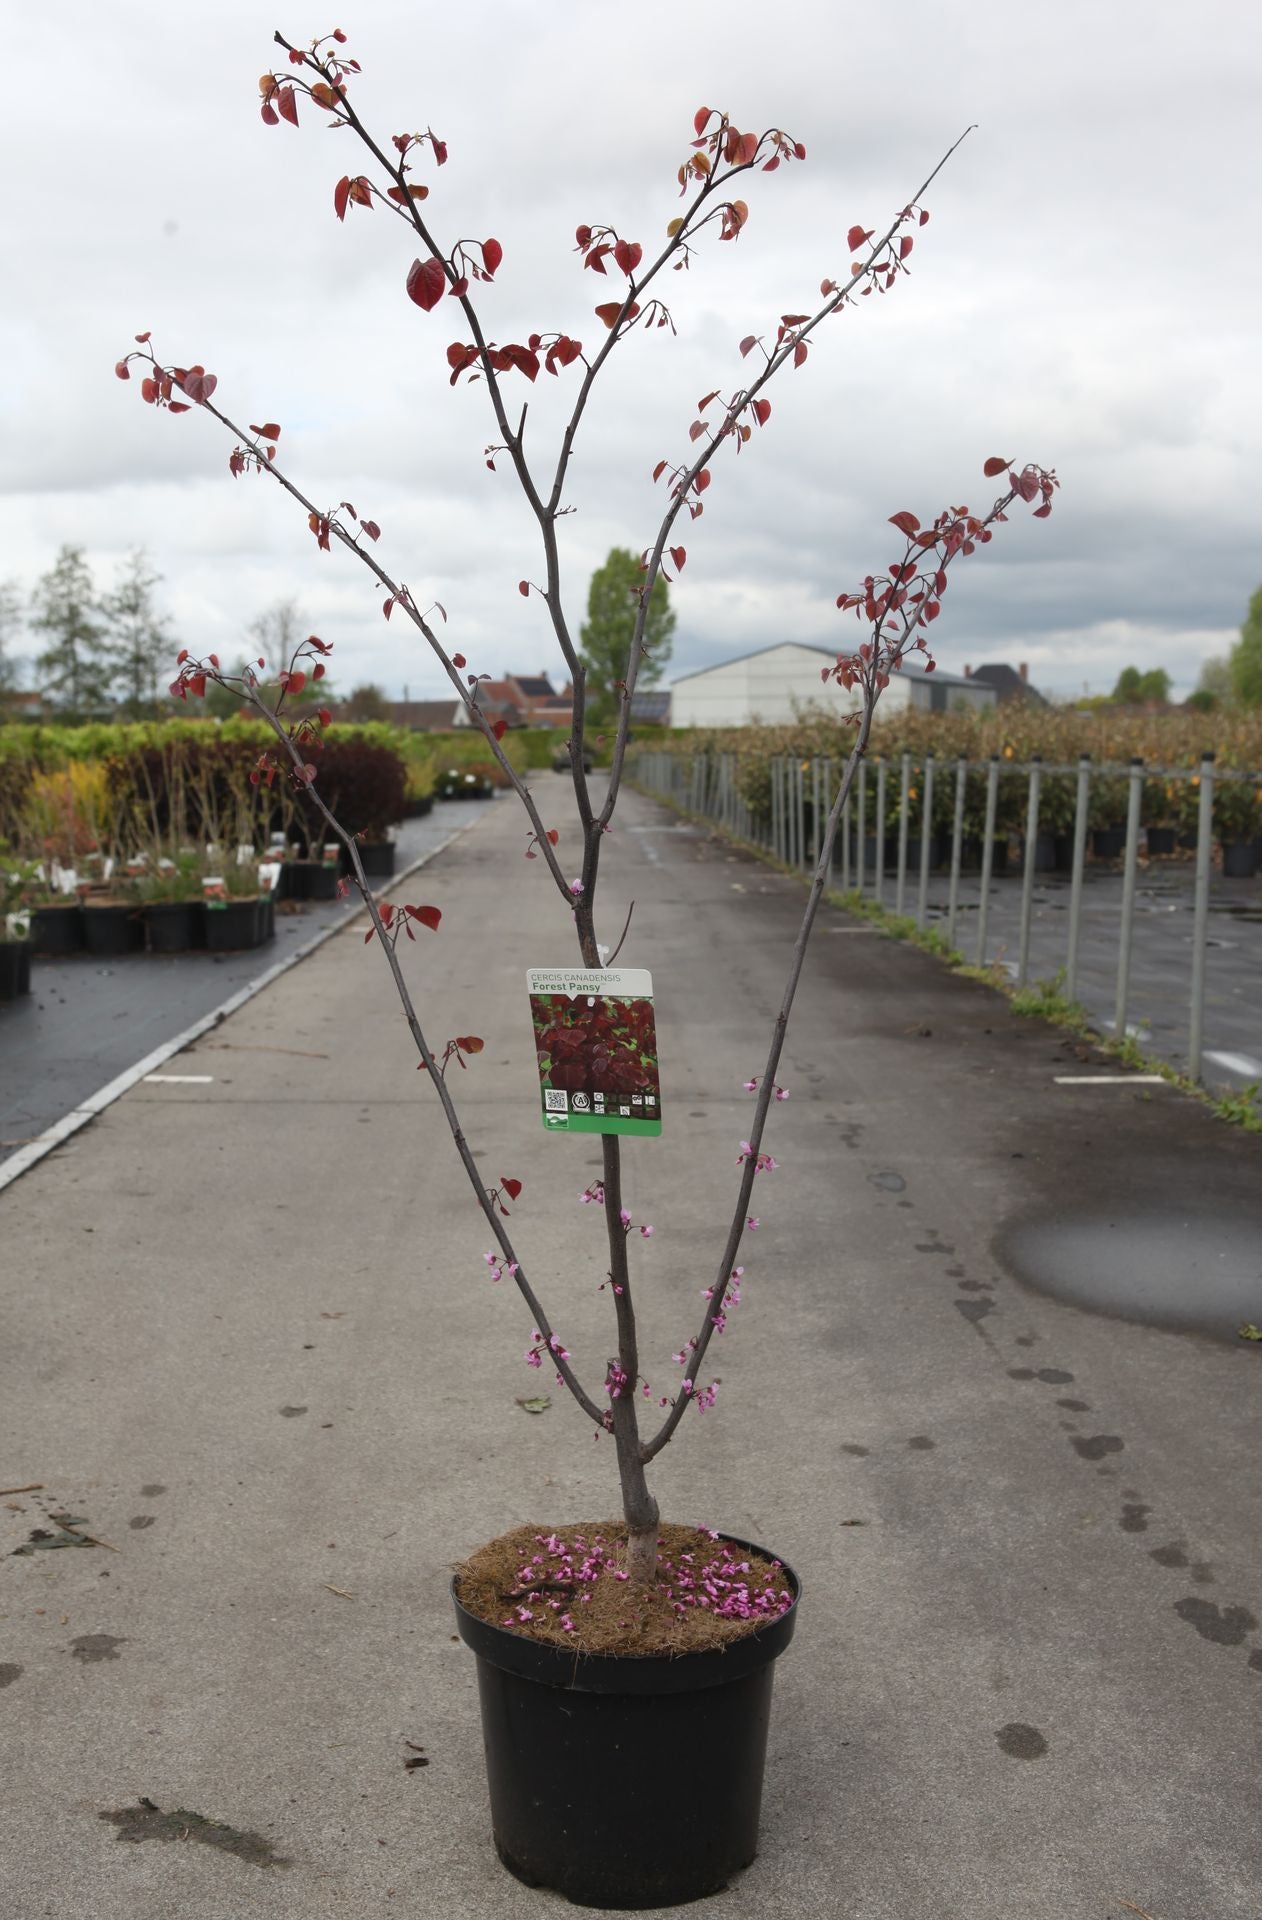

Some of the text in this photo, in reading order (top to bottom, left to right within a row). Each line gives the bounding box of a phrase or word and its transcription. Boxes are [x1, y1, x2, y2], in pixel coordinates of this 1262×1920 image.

[564, 974, 621, 982] CANADENSIS
[532, 982, 566, 990] Forest
[569, 982, 600, 992] Pansy
